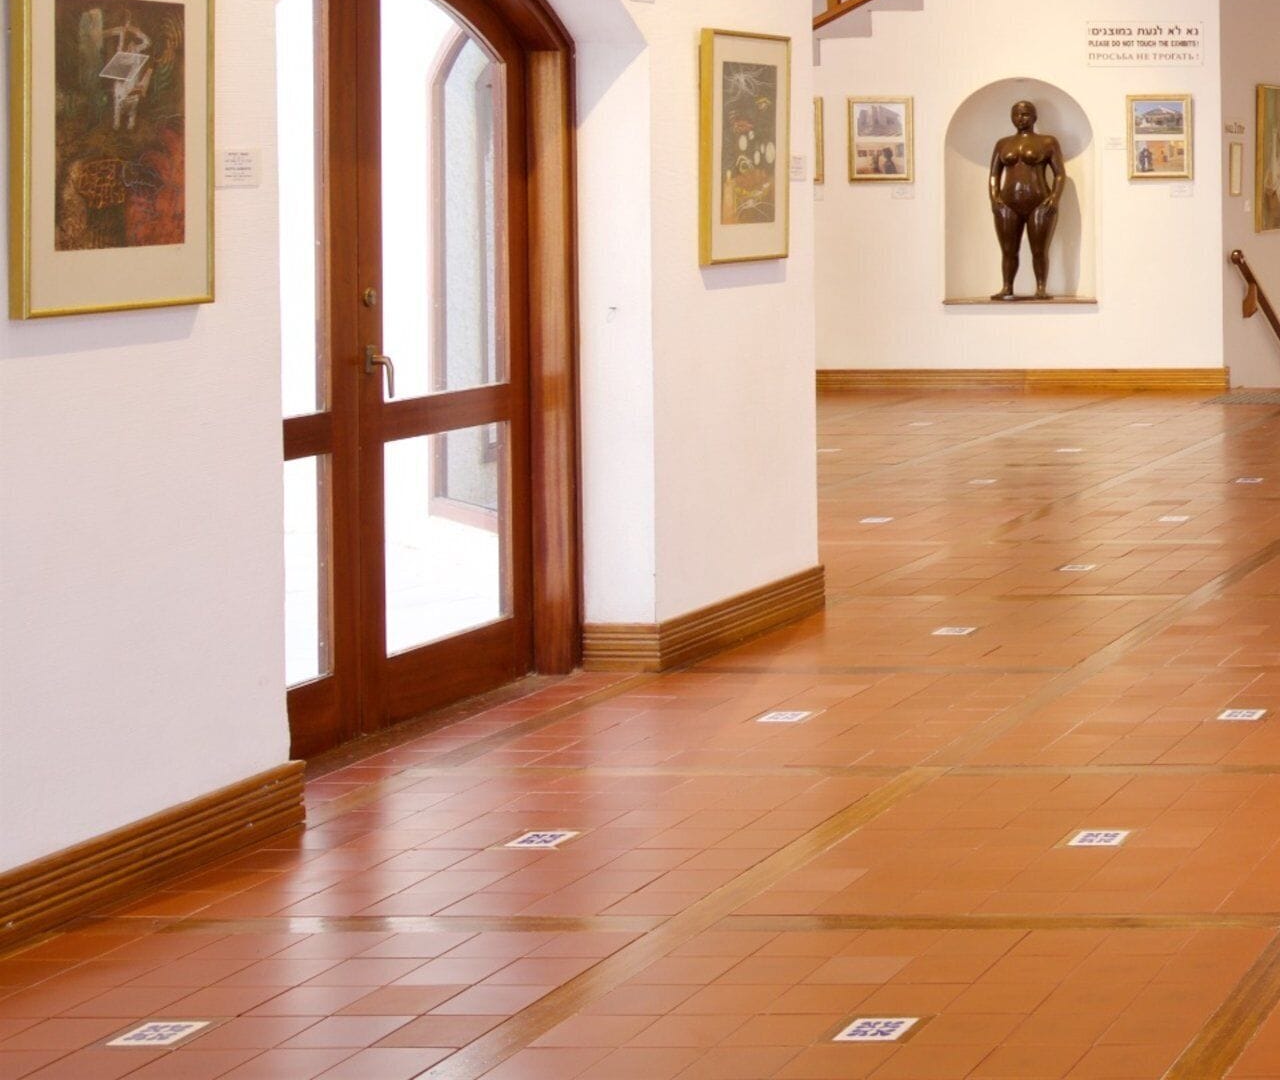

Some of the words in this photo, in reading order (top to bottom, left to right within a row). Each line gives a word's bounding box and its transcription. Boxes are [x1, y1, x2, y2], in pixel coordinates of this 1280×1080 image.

[1137, 25, 1163, 36] לגעת
[1167, 25, 1181, 36] לא
[1186, 27, 1199, 36] נא
[1088, 52, 1134, 61] ПРОСЬБА
[1136, 52, 1150, 61] НЕ
